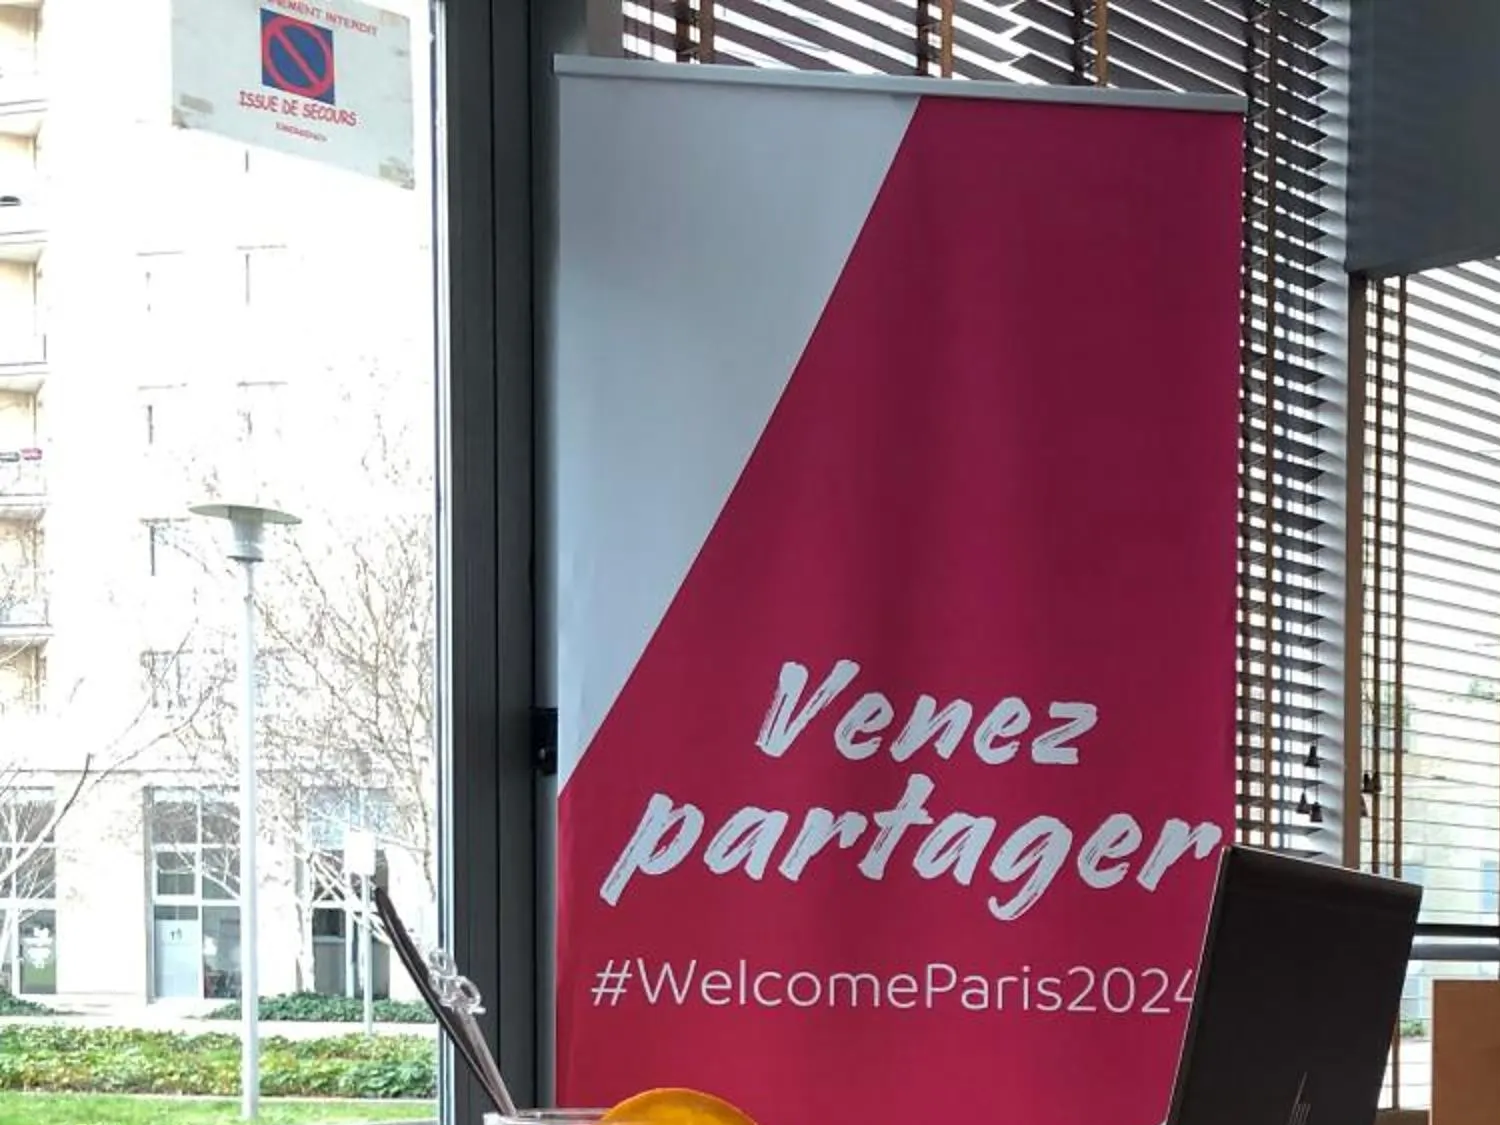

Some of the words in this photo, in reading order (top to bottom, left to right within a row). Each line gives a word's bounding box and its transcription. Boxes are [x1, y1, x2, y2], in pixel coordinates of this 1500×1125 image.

[239, 90, 279, 113] ISSUE
[282, 98, 299, 117] DE
[302, 103, 358, 127] SECOURS
[755, 658, 1099, 766] Venez
[599, 773, 1222, 921] partager
[591, 958, 1194, 1014] #WelcomeParis2024
